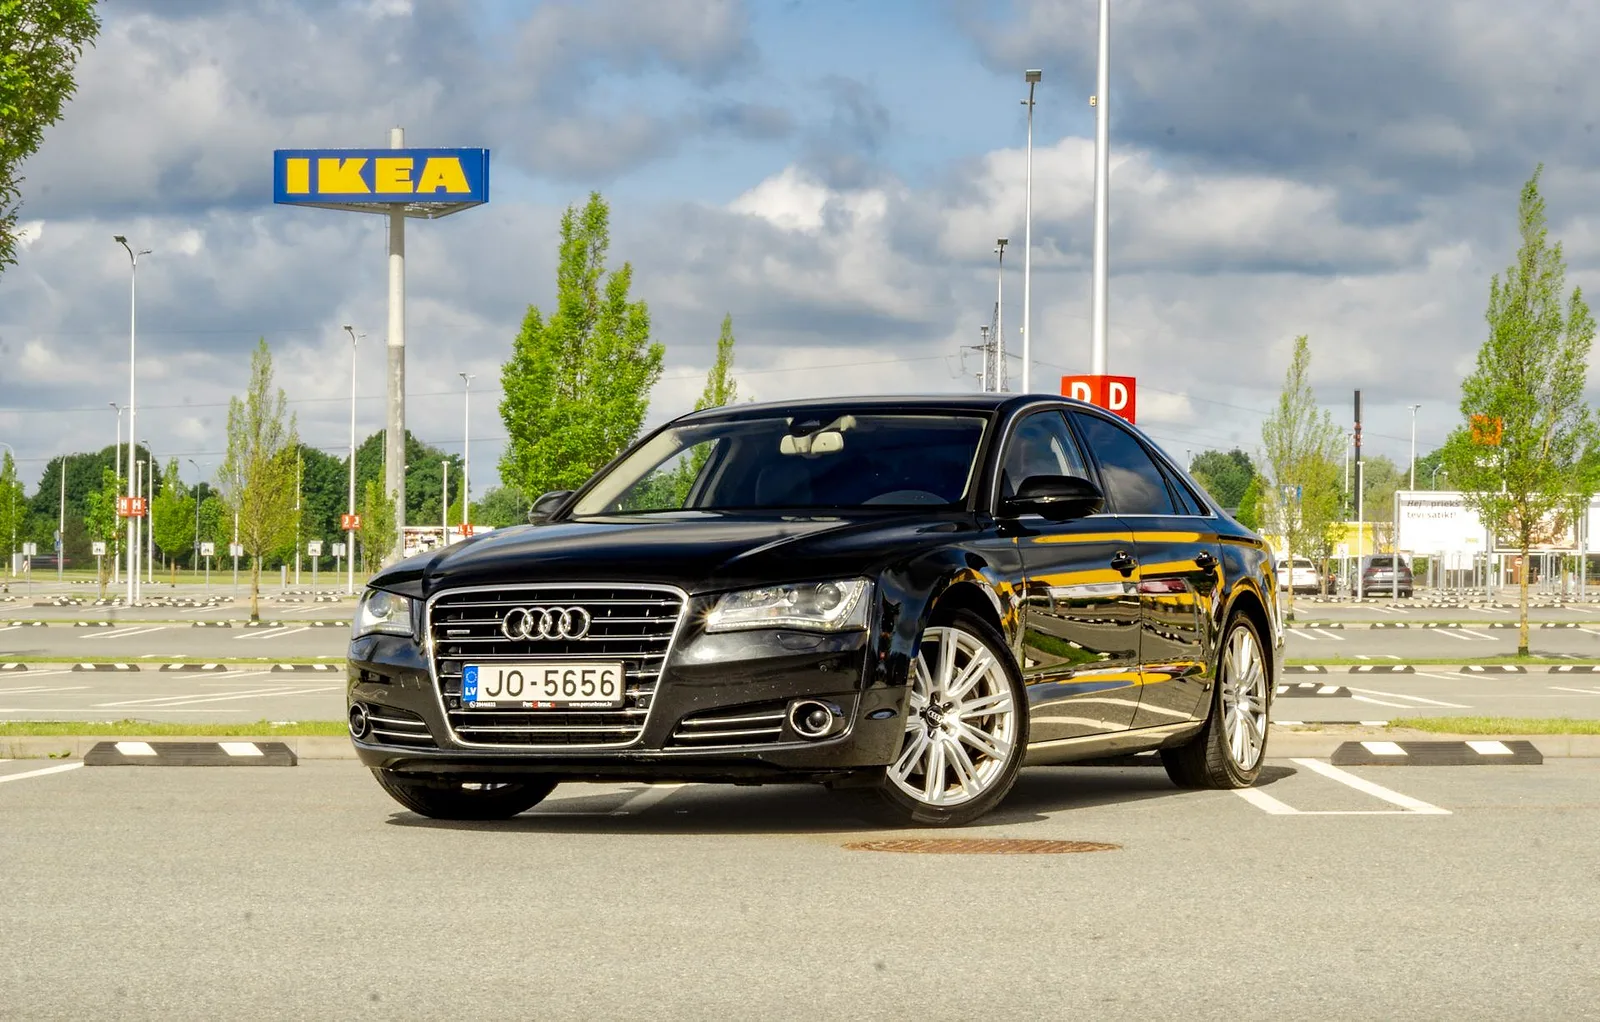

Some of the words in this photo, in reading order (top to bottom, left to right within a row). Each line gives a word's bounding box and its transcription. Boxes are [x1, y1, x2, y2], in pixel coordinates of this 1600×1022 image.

[286, 157, 472, 194] IKEA
[1071, 381, 1092, 404] D
[1109, 381, 1128, 411] D
[120, 499, 127, 510] H
[132, 499, 142, 510] H
[465, 686, 477, 696] LV
